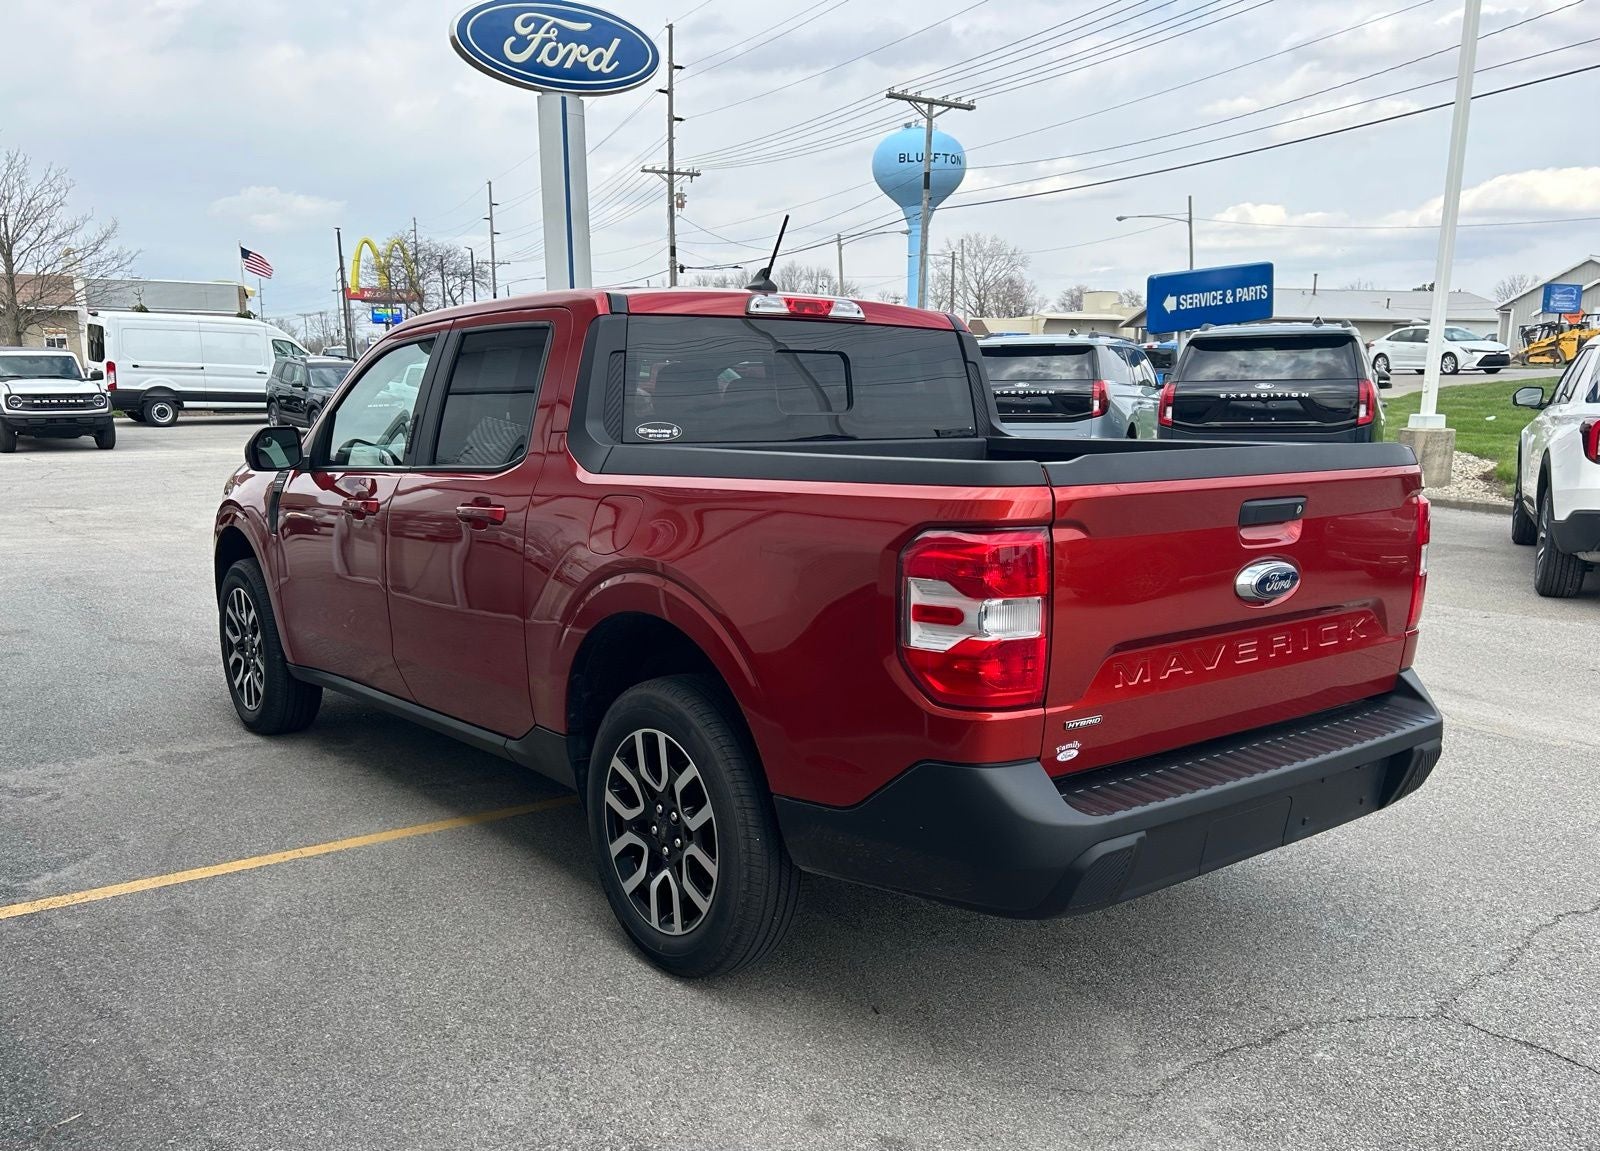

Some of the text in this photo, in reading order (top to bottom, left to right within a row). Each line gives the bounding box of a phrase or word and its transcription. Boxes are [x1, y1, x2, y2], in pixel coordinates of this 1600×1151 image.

[503, 12, 621, 74] Ford
[898, 153, 962, 165] BLUFTON
[1179, 284, 1268, 310] SERVICE & PARTS
[1266, 572, 1293, 592] Ford
[1114, 616, 1374, 689] MAVERICK
[1068, 717, 1101, 729] HYBRID
[1055, 740, 1082, 753] Family
